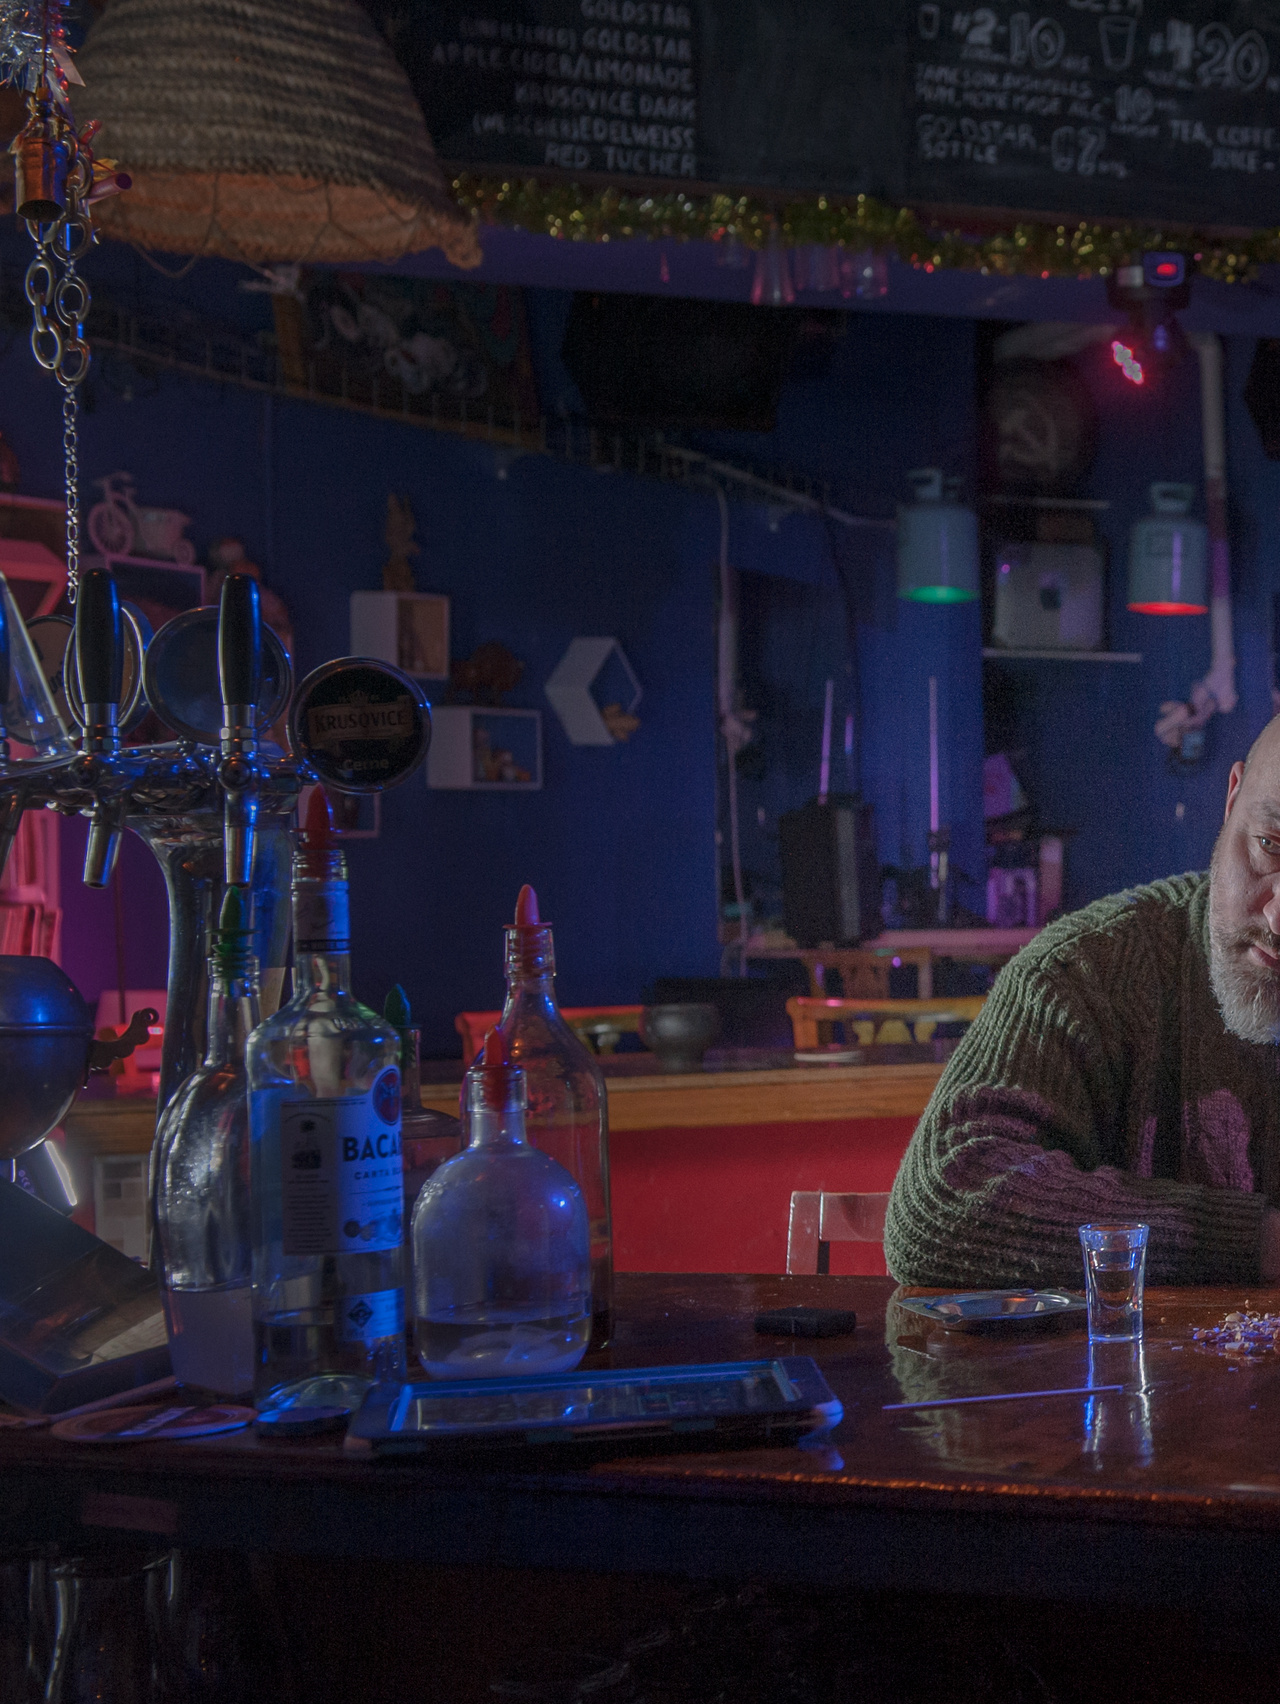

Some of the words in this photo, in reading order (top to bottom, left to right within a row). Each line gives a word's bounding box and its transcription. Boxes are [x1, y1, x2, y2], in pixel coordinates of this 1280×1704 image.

[431, 41, 503, 70] APPLE
[582, 27, 692, 62] GOLDSTAR
[639, 93, 697, 120] DARK
[544, 141, 591, 170] RED
[602, 145, 697, 178] TUCHER
[922, 139, 999, 165] BOTTLE
[343, 1131, 401, 1162] BACA
